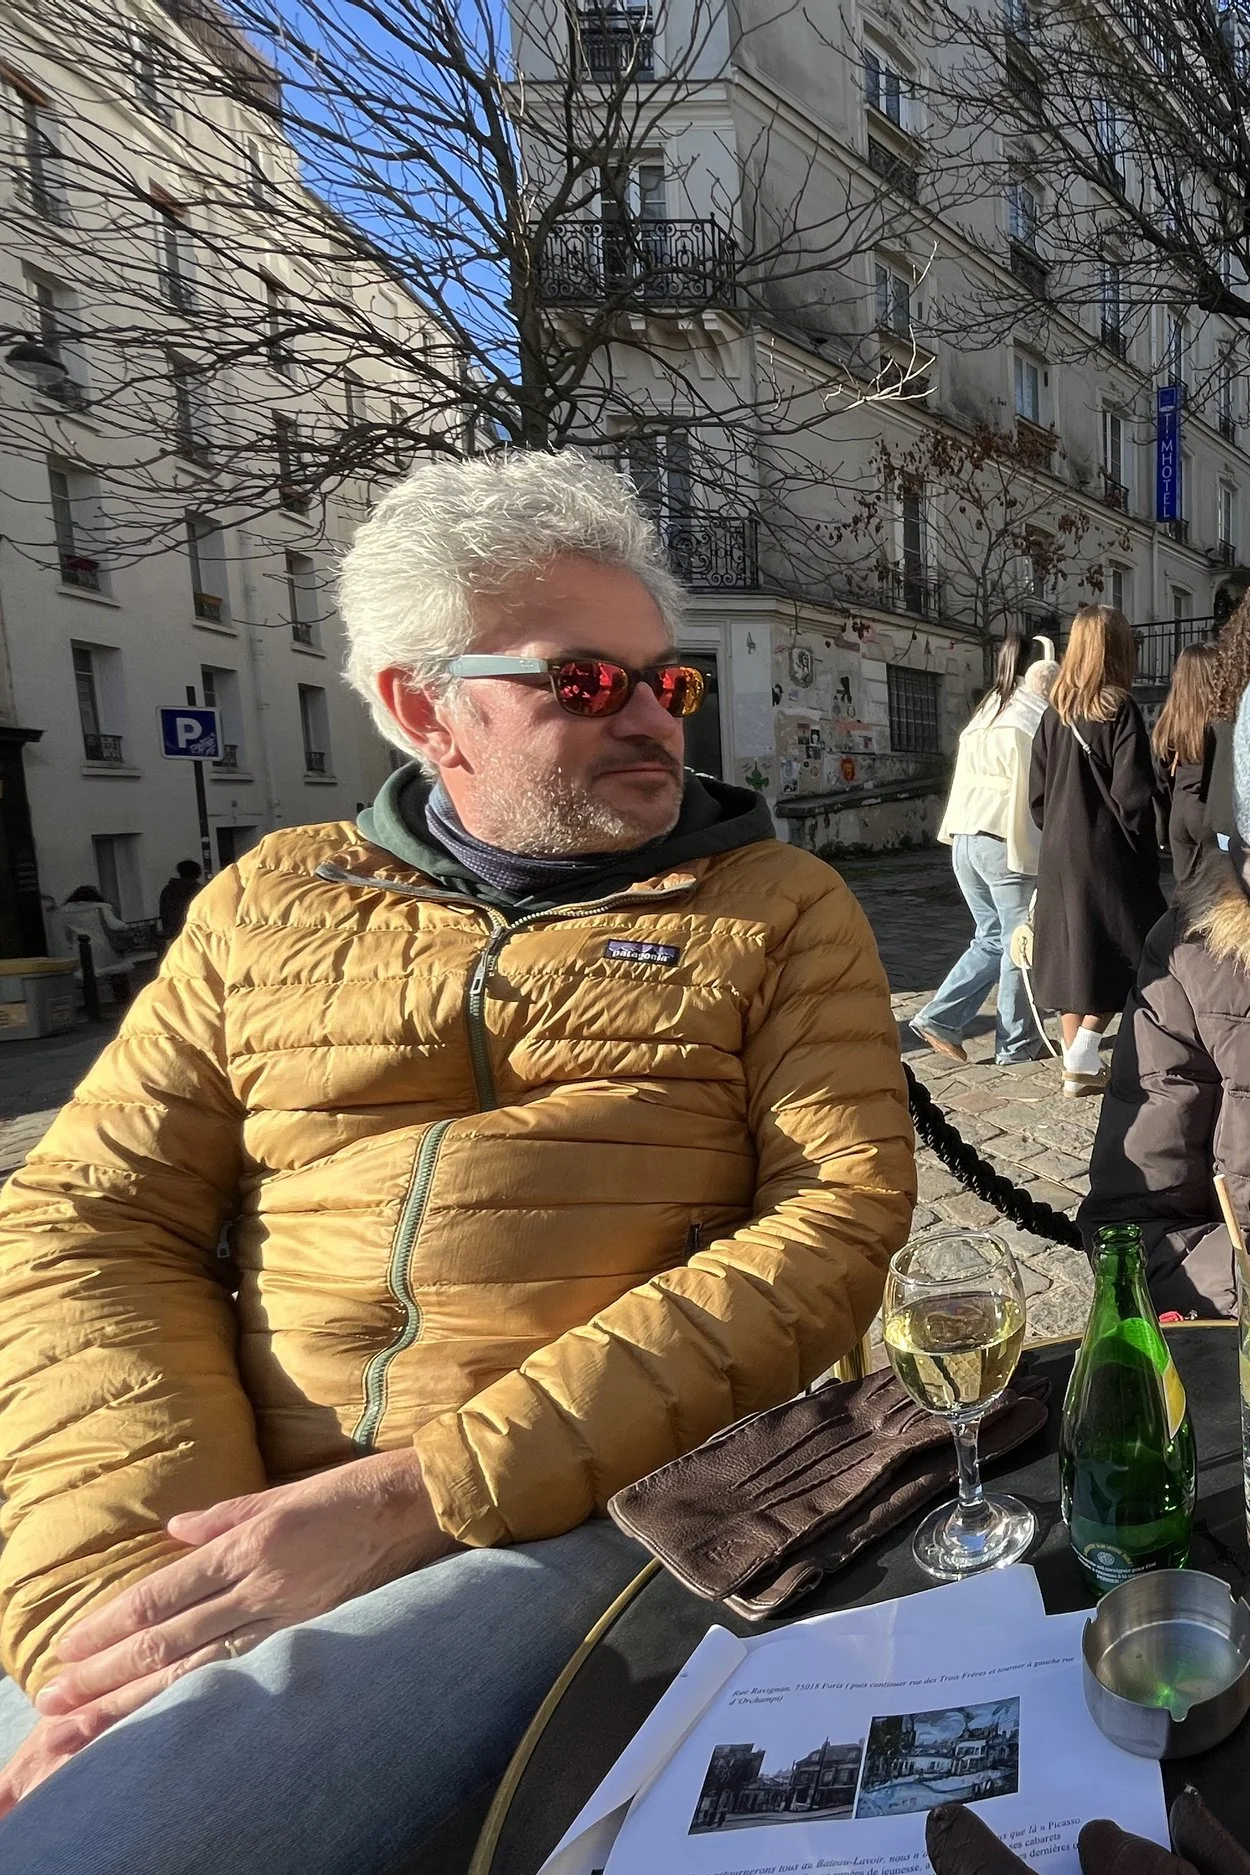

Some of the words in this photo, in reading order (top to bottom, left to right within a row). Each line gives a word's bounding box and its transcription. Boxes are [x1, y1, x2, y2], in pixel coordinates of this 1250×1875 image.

[1161, 413, 1173, 518] TIMHOTEL
[175, 717, 202, 748] P
[612, 949, 668, 962] patagonia
[795, 1683, 820, 1691] 75018
[821, 1681, 843, 1691] Paris
[869, 1679, 906, 1689] continuer
[923, 1676, 937, 1685] des
[939, 1674, 960, 1683] Trois
[997, 1663, 1026, 1673] tourner
[1033, 1657, 1061, 1668] gauche
[1009, 1828, 1026, 1839] que
[1028, 1823, 1038, 1834] là
[1024, 1832, 1062, 1847] cabarets
[1029, 1842, 1071, 1858] dernières
[778, 1862, 799, 1873] tous
[889, 1854, 911, 1863] nous
[867, 1867, 879, 1875] de
